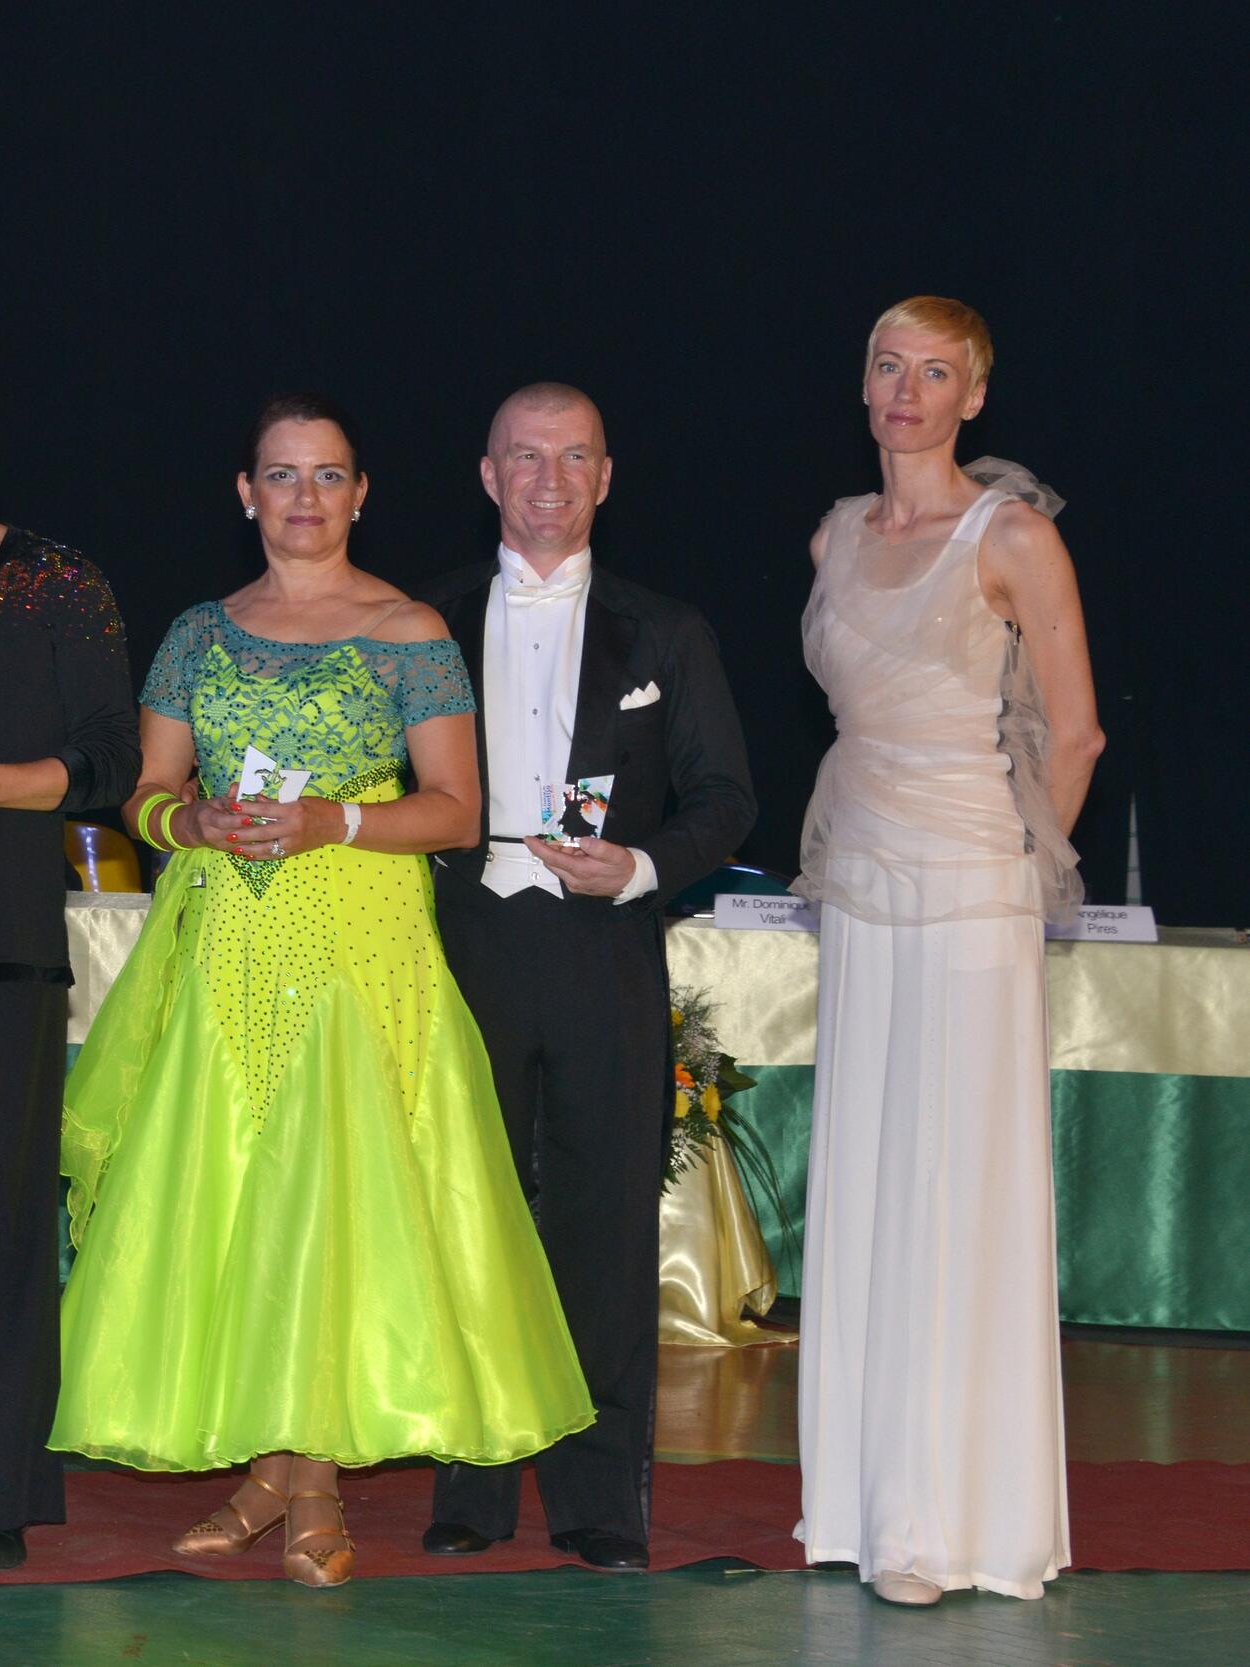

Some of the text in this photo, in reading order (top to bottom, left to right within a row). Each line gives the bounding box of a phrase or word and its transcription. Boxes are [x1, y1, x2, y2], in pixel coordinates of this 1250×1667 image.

[732, 898, 811, 912] Mr. Dominique
[1087, 923, 1119, 935] Pires
